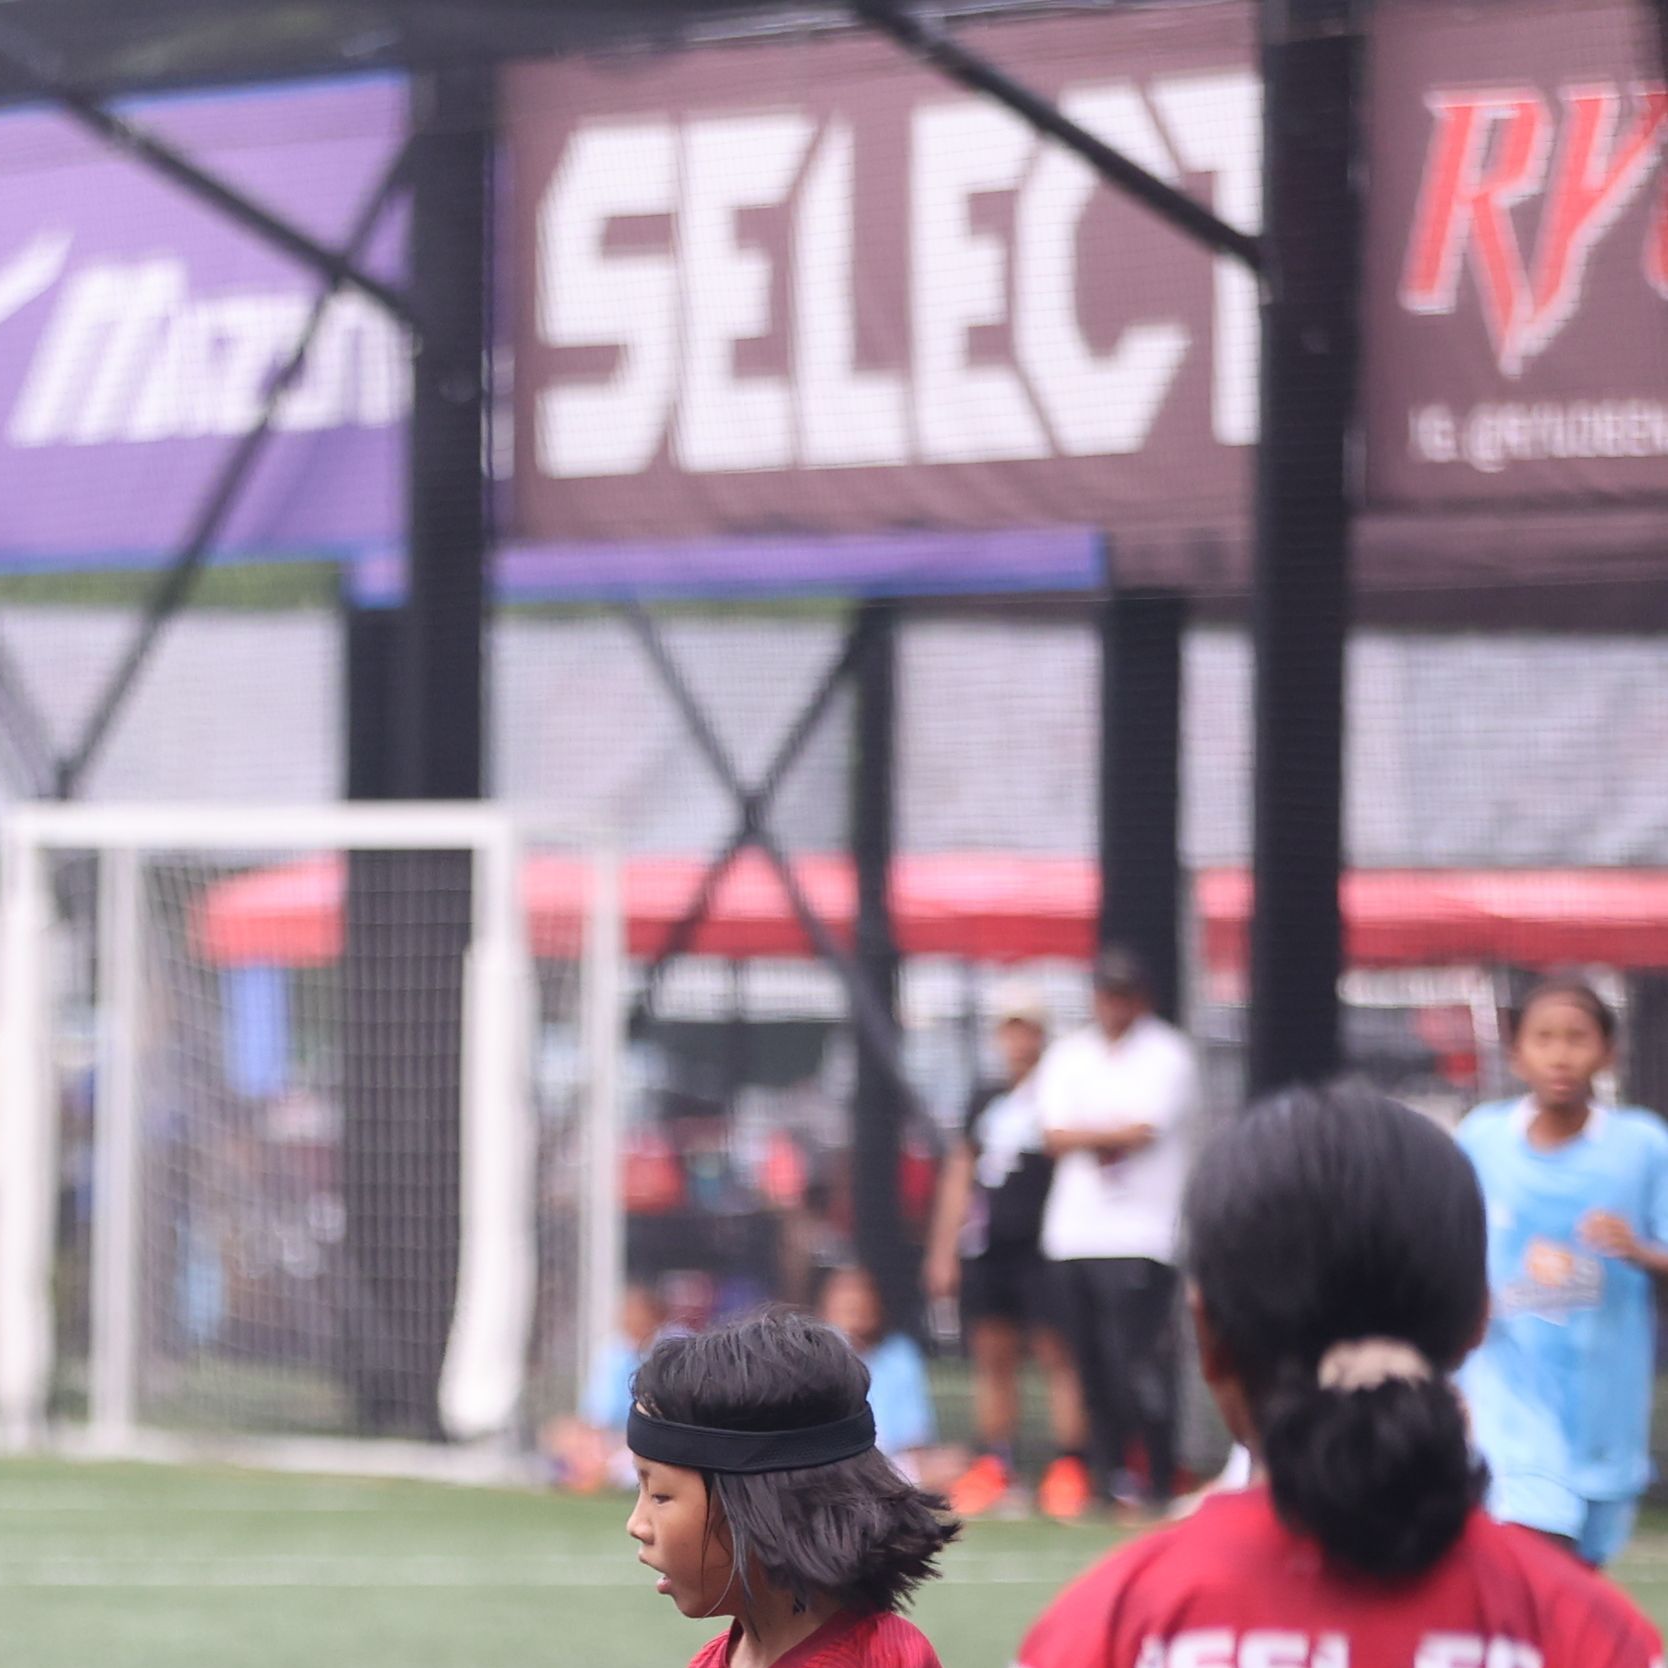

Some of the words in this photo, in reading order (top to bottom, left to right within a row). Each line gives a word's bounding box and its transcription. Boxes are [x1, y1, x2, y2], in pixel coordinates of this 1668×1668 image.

[5, 254, 416, 448] MIZUN
[534, 70, 1264, 480] SELECT
[1396, 80, 1668, 381] RY
